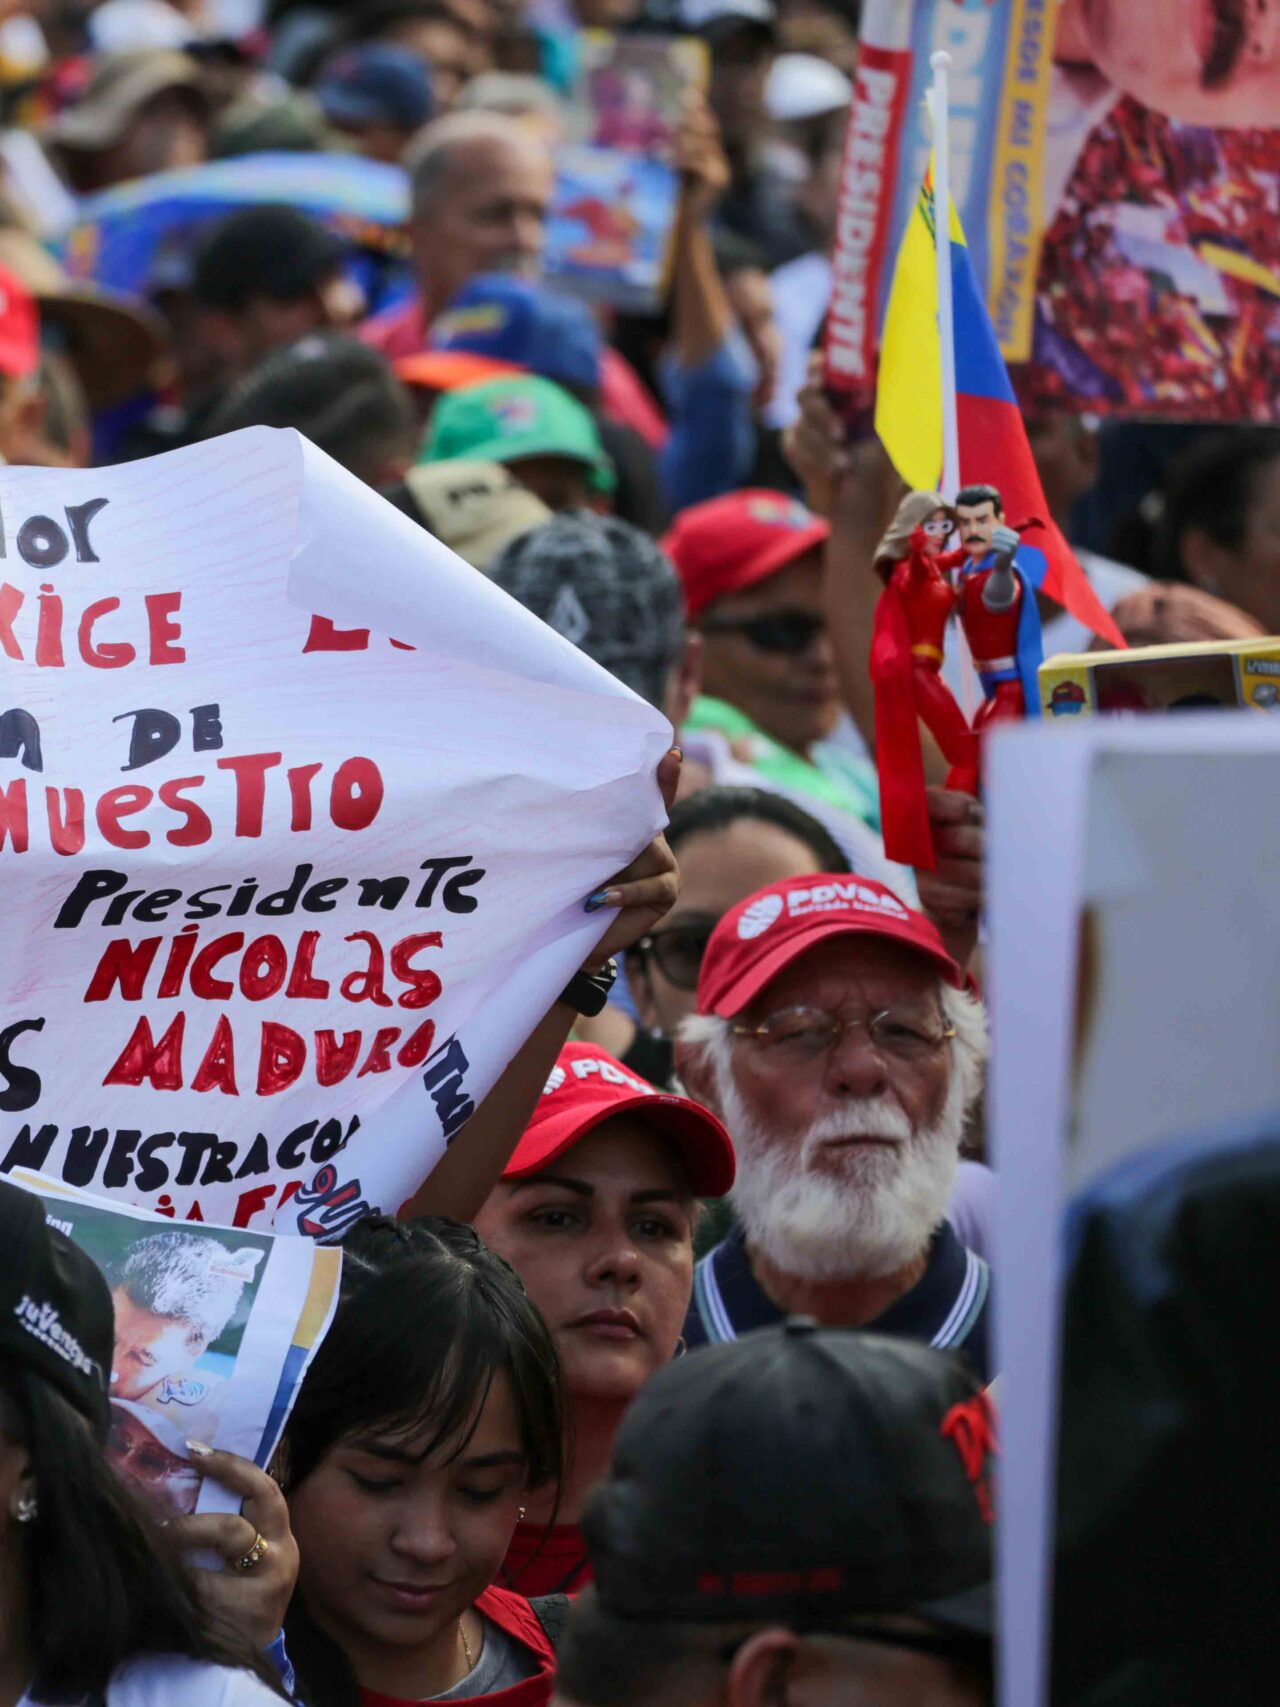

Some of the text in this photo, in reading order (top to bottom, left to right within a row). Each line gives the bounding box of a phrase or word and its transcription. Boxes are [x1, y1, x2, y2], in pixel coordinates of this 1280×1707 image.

[826, 66, 897, 379] PRESIDENTE
[112, 703, 224, 771] DE
[102, 1010, 435, 1097] MADURO
